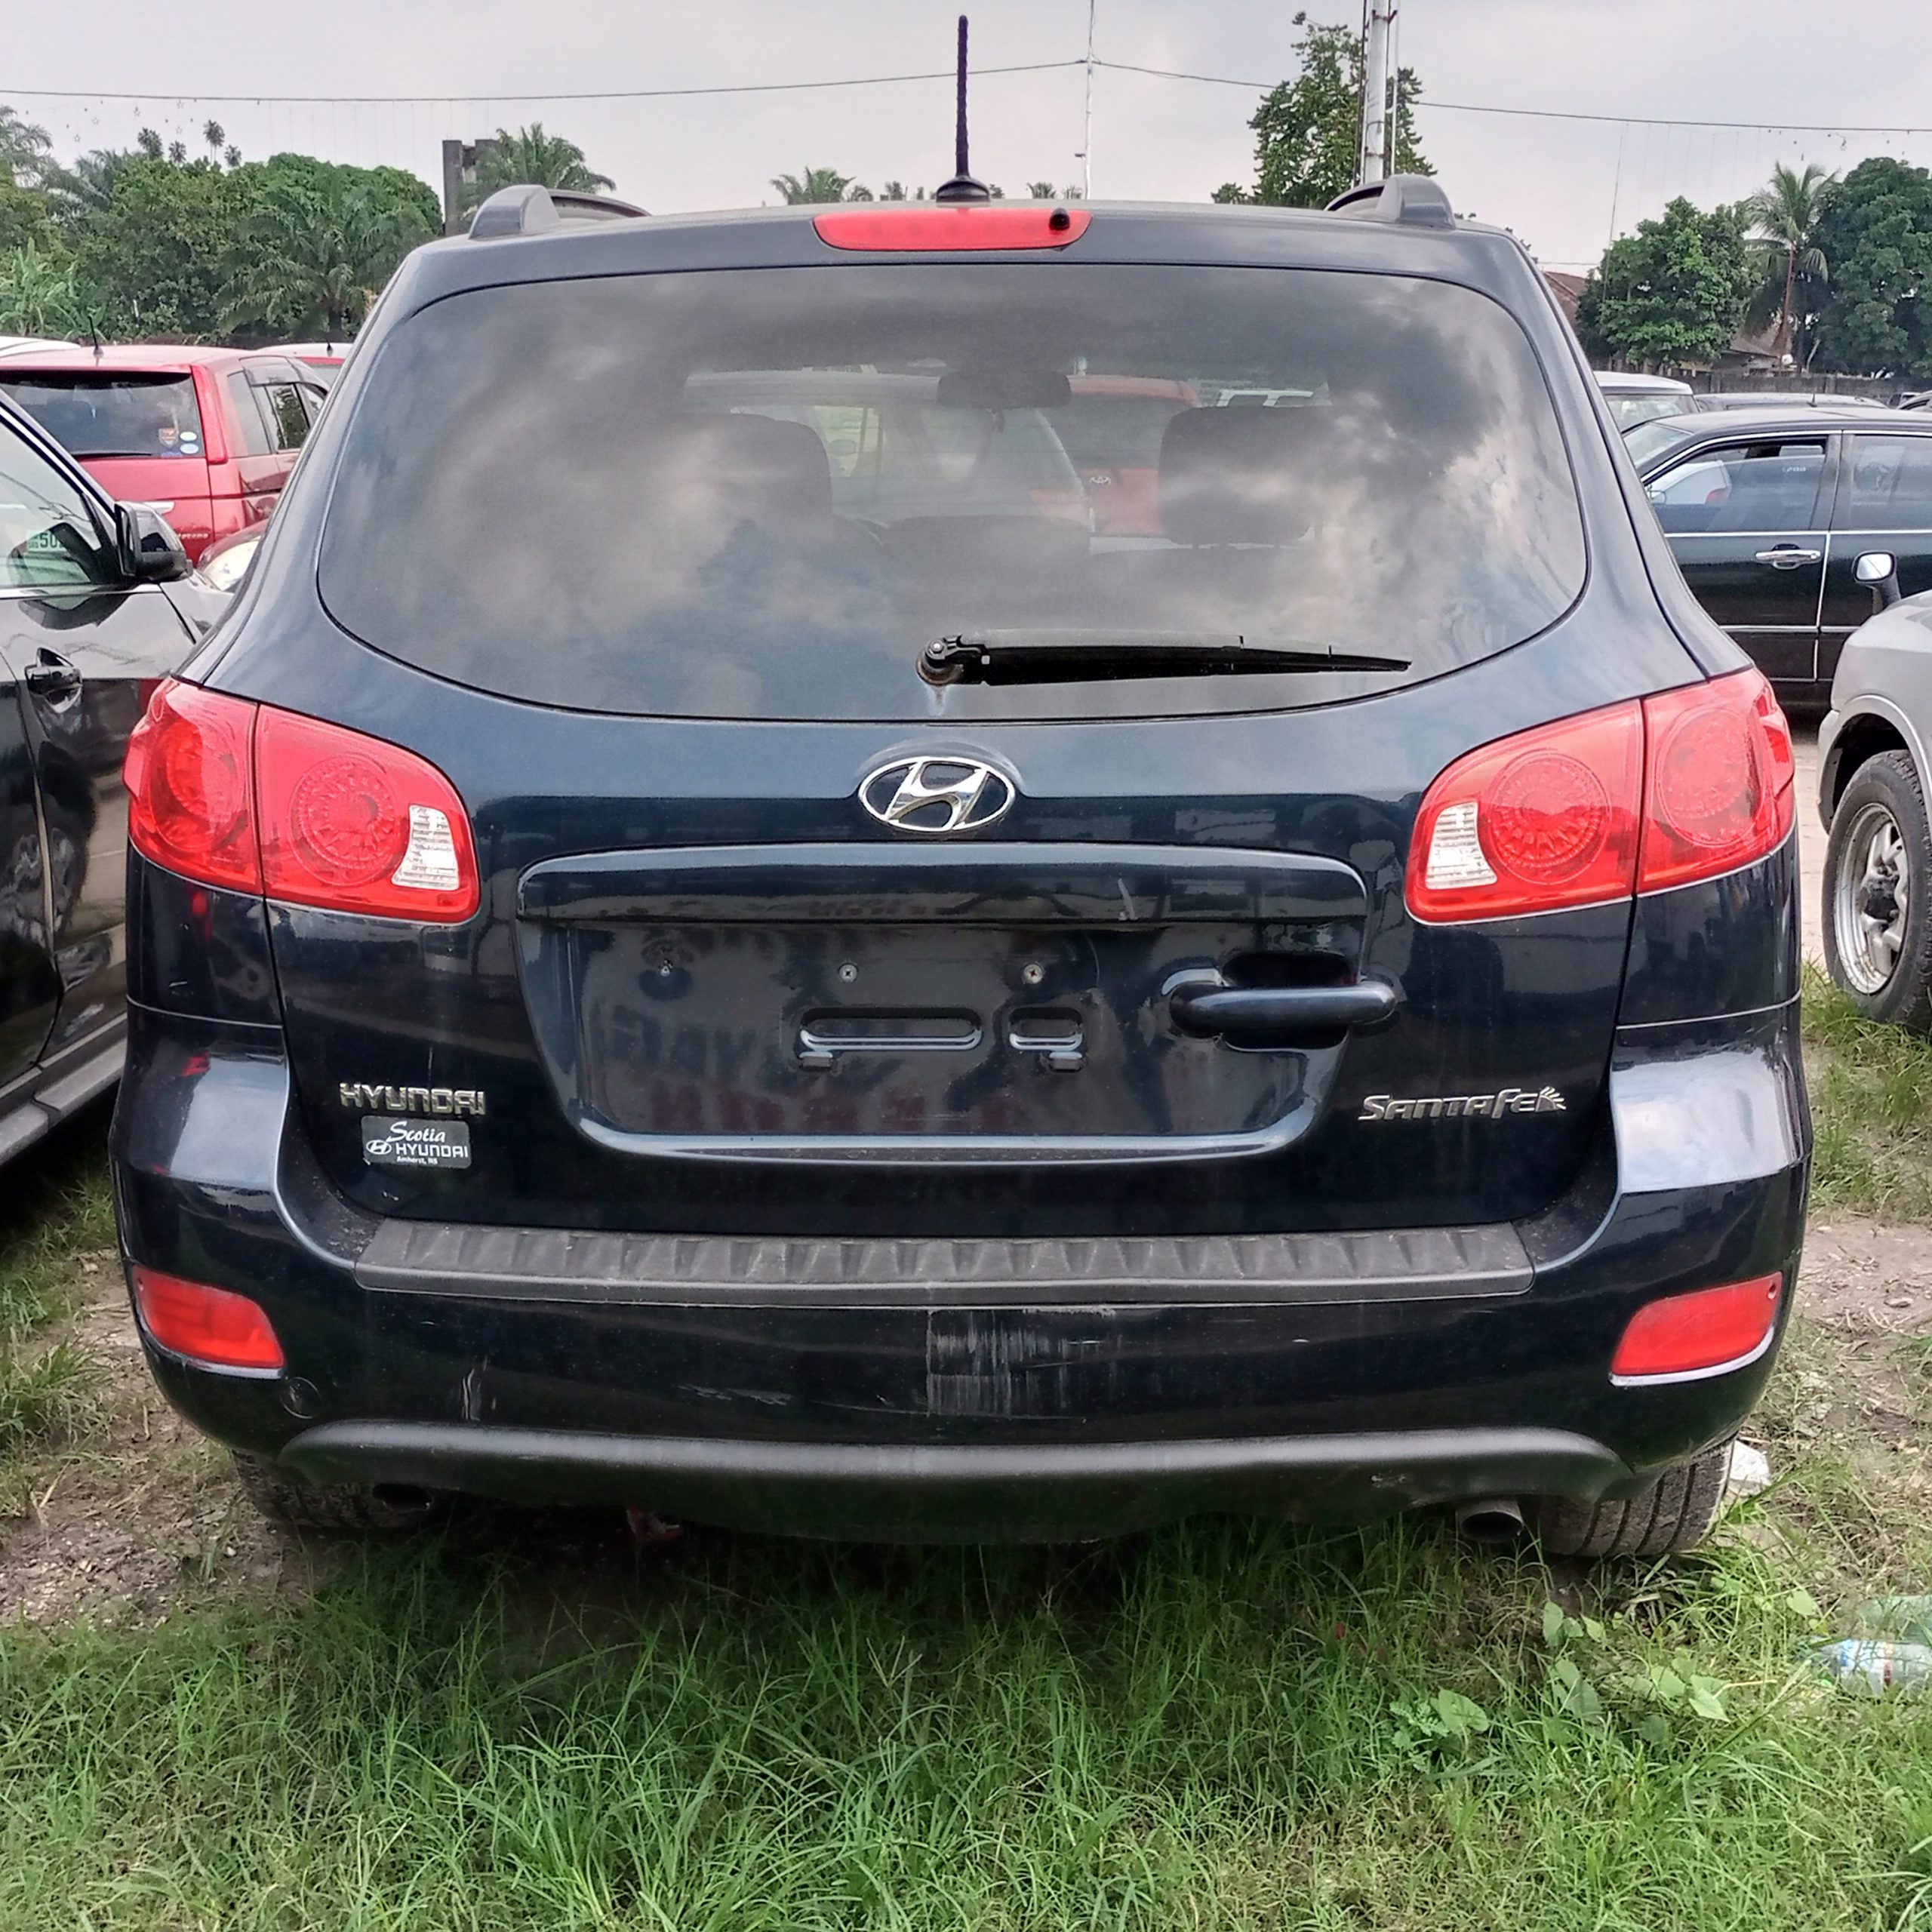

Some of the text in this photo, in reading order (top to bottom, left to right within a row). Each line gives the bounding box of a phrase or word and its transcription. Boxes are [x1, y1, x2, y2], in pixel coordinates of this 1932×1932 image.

[340, 1082, 486, 1115] HYUNDAI
[386, 1120, 445, 1143] Scotia
[395, 1143, 469, 1158] HYUNDAI
